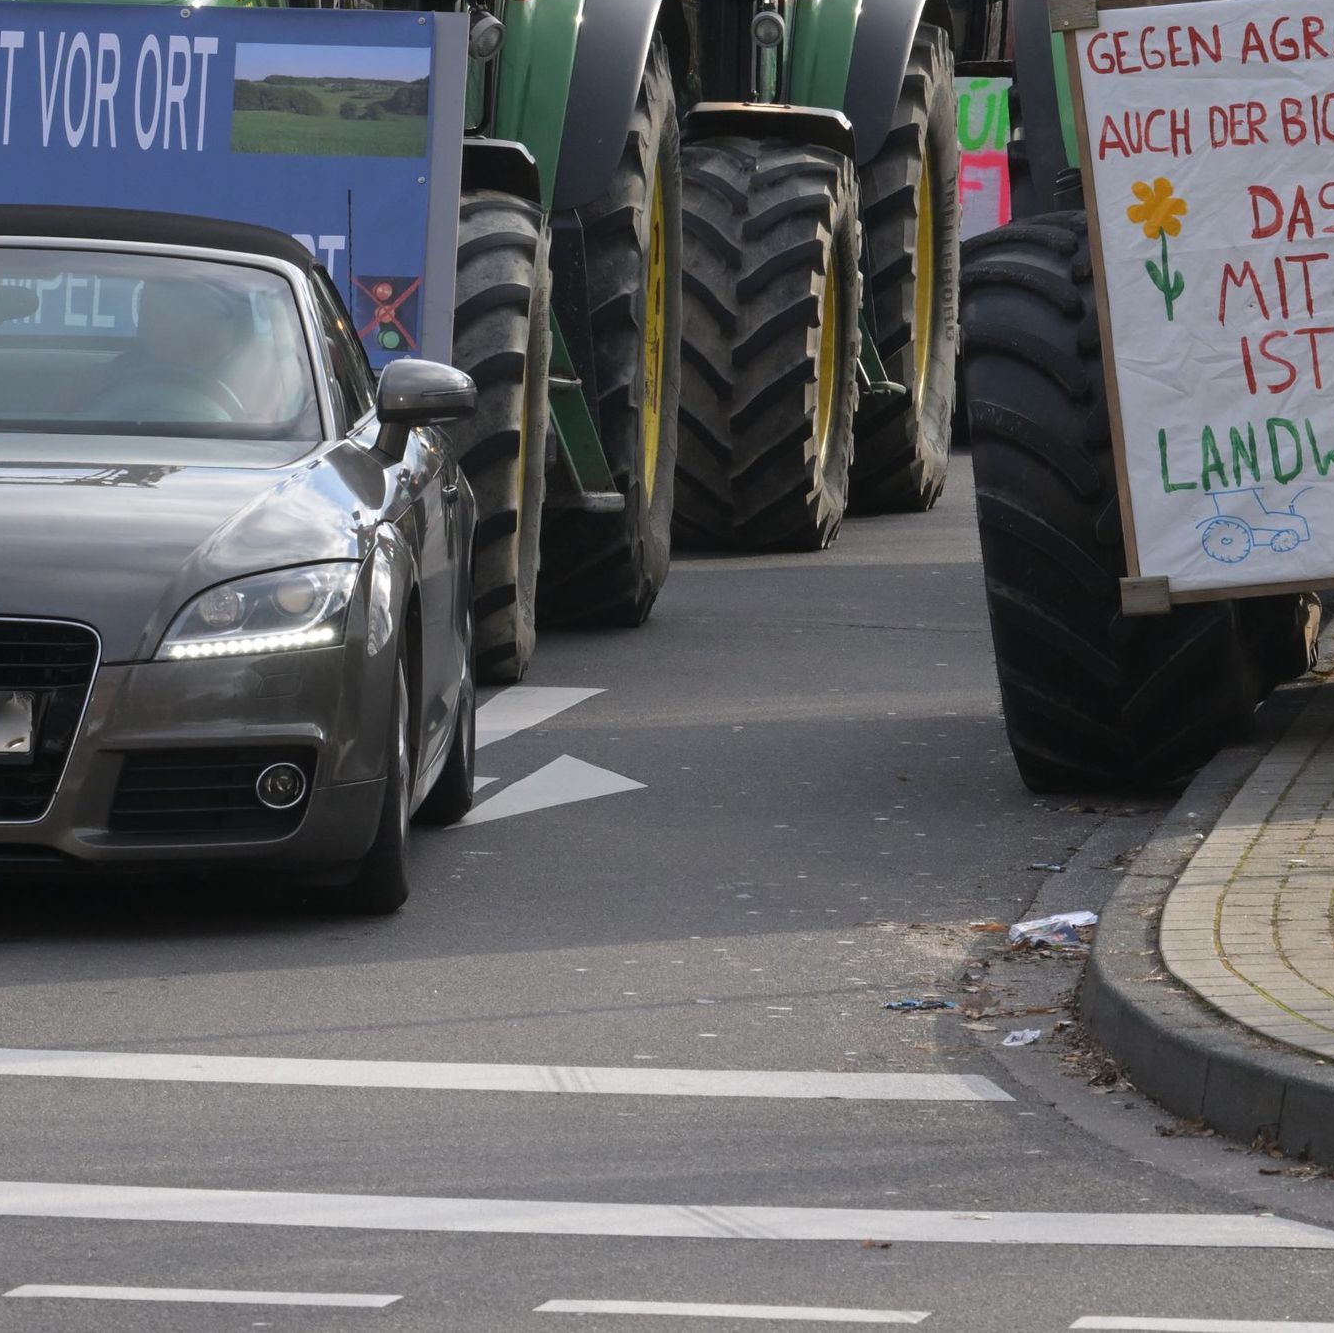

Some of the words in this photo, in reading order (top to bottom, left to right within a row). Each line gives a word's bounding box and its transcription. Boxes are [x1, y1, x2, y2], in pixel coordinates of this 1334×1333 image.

[1087, 24, 1223, 74] GEGEN
[39, 30, 122, 148] VOR
[134, 33, 219, 151] ORT
[1098, 108, 1192, 160] AUCH
[1208, 101, 1269, 149] DER
[1219, 253, 1329, 327] MIT
[1241, 326, 1334, 395] IST
